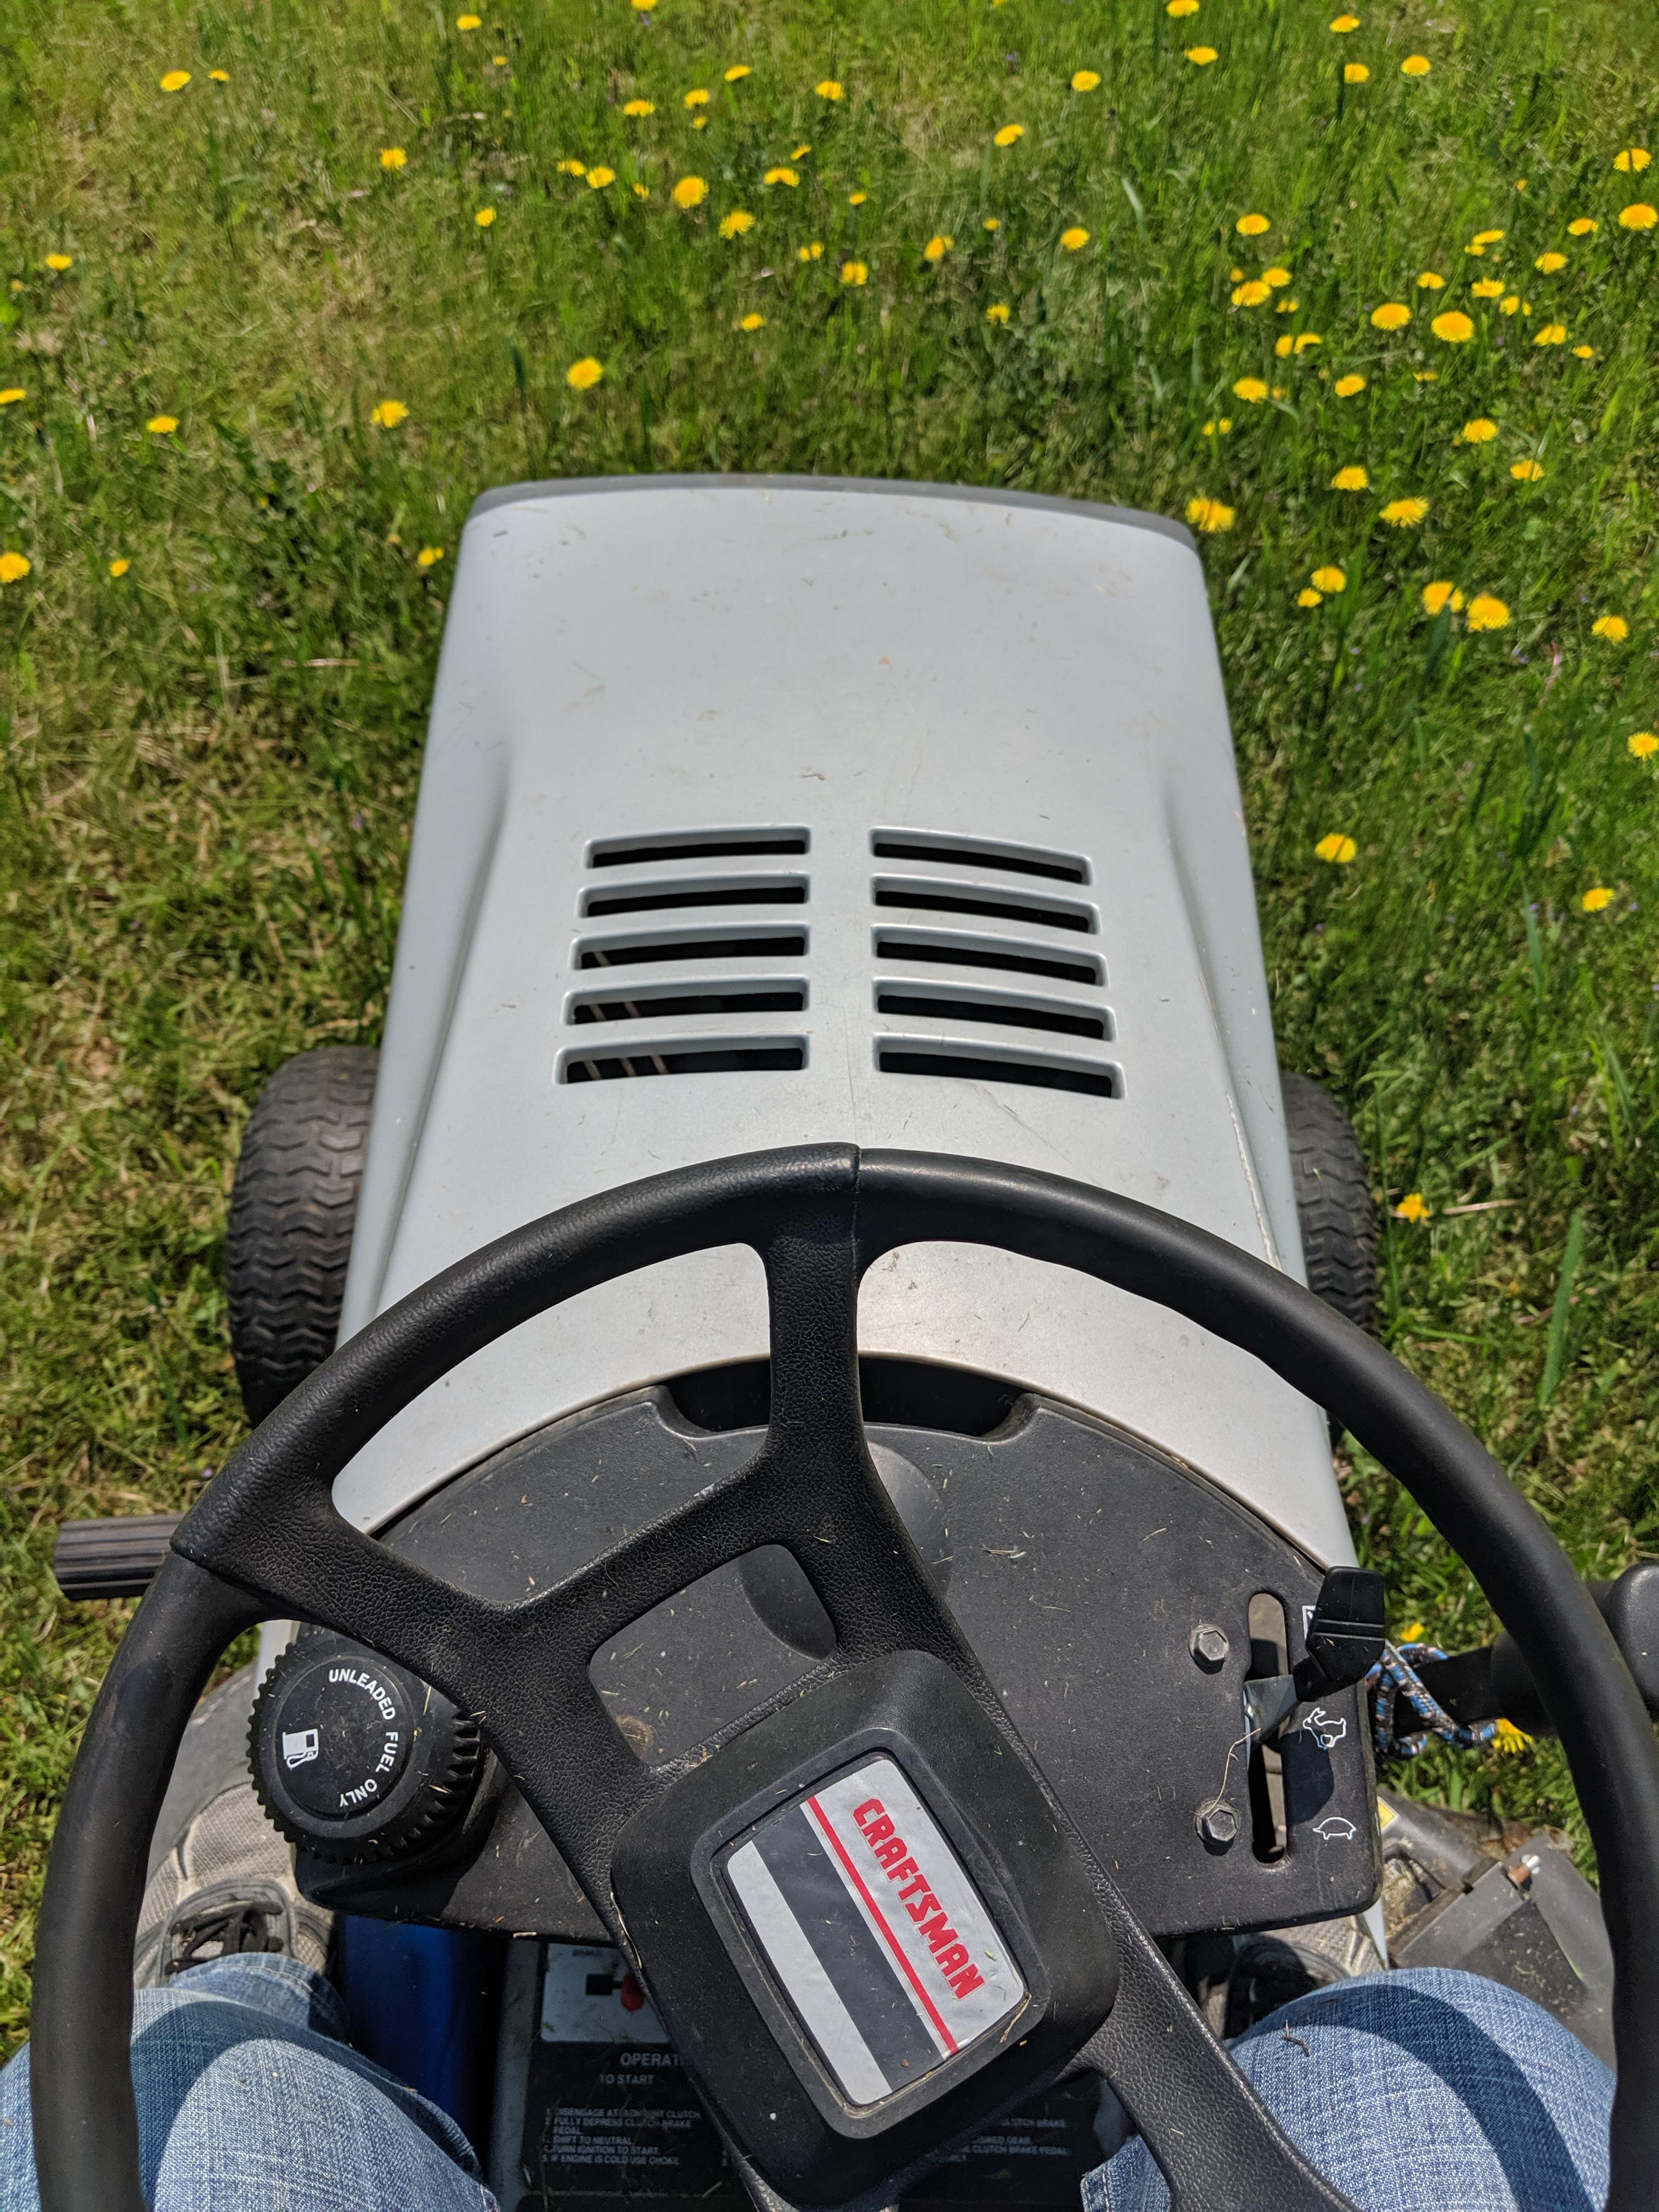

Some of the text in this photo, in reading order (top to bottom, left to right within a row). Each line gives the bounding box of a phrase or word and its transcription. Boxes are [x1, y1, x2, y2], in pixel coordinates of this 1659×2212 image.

[329, 1668, 399, 1808] UNLEADED FUEL ONLY
[853, 1798, 986, 2000] CRAFTSMAN
[599, 2074, 654, 2085] TO START
[604, 2155, 628, 2164] COLD
